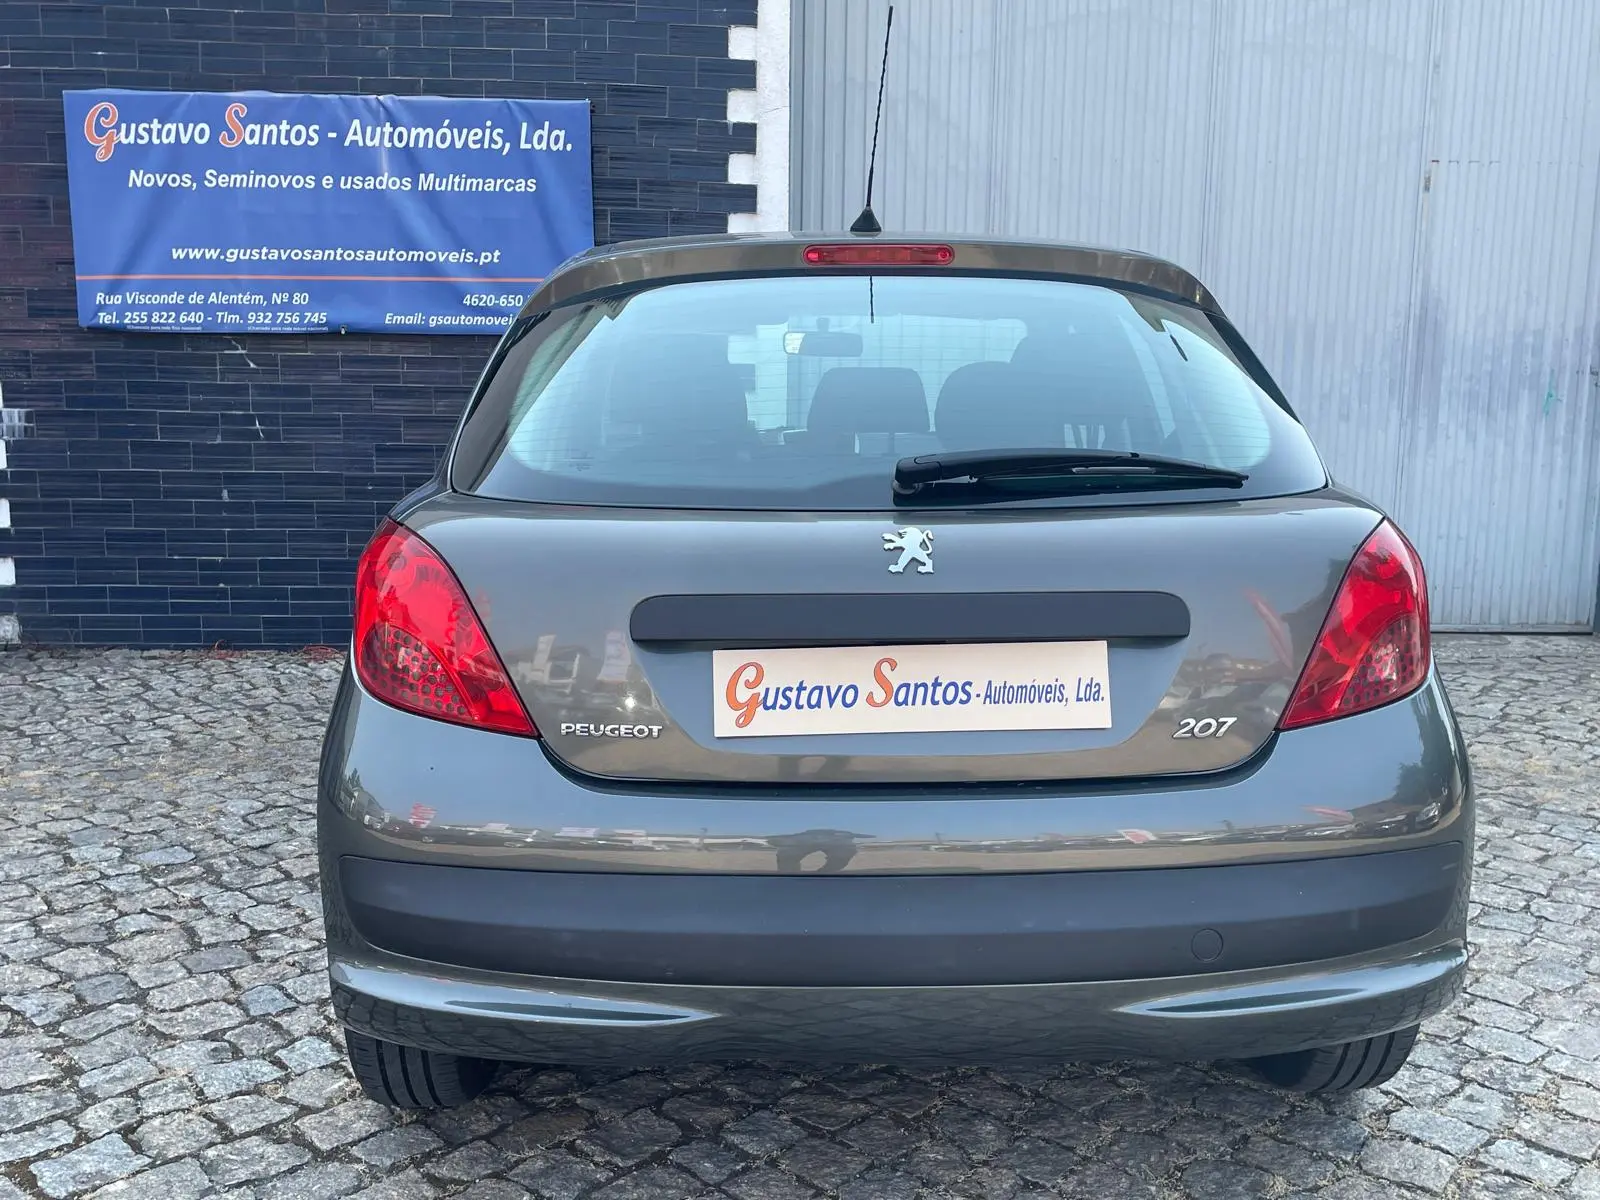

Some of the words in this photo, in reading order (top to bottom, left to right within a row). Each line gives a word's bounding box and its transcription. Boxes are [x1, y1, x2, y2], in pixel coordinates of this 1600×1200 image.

[84, 102, 210, 161] Gustavo
[219, 103, 319, 148] Santos
[344, 118, 511, 156] Automóveis,
[519, 121, 572, 151] Lda.
[128, 169, 197, 190] Novos,
[204, 169, 316, 189] Seminovos
[322, 174, 333, 189] e
[340, 172, 412, 190] usados
[418, 173, 537, 192] Multimarcas
[172, 246, 501, 265] www.gustavosantosautomoveis.pt
[96, 292, 122, 305] Rua
[126, 291, 185, 305] Visconde
[188, 292, 204, 305] de
[208, 291, 267, 307] Alentém,
[292, 292, 309, 305] 80
[463, 294, 523, 307] 4620-650
[98, 312, 120, 324] Tel.
[124, 311, 148, 324] 255
[151, 311, 176, 324] 822
[179, 311, 204, 324] 640
[216, 312, 244, 324] Tlm.
[248, 312, 272, 324] 932
[276, 312, 300, 324] 756
[304, 312, 327, 324] 745
[385, 312, 426, 325] Email:
[429, 314, 515, 327] gsautomovei
[726, 661, 859, 728] Gustavo
[866, 657, 973, 708] Santos
[1075, 677, 1105, 703] Lda.
[560, 722, 662, 738] PEUGEOT
[1173, 717, 1238, 738] 207
